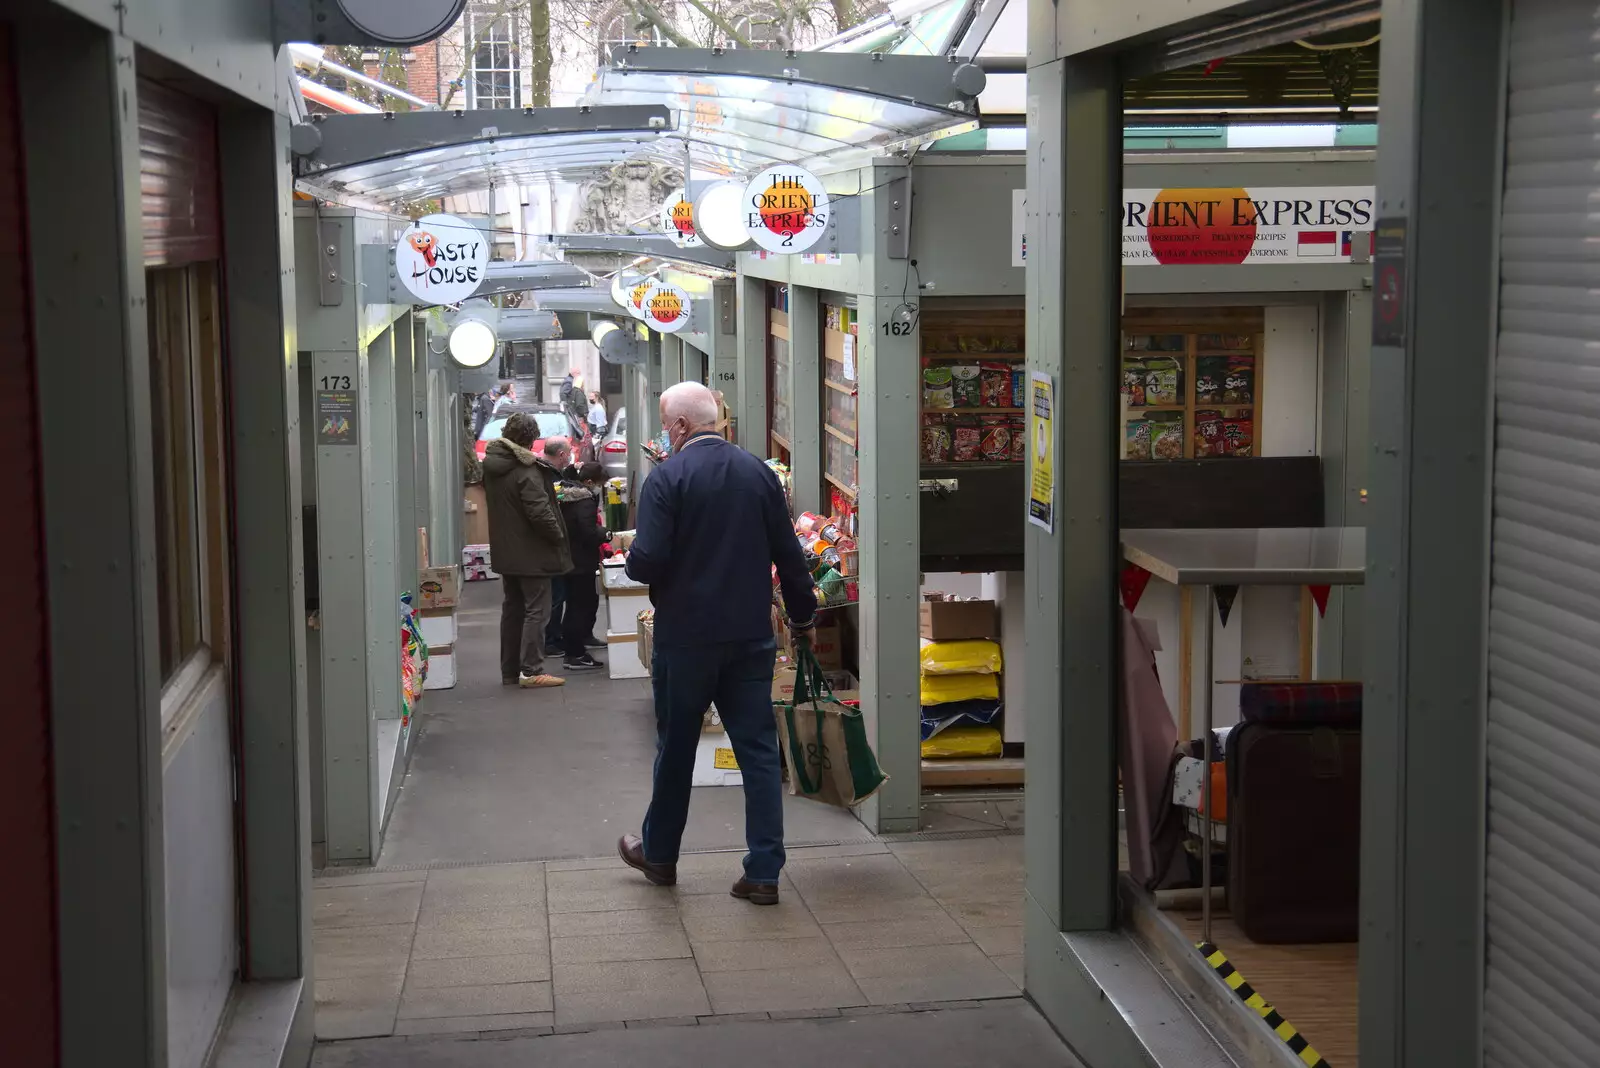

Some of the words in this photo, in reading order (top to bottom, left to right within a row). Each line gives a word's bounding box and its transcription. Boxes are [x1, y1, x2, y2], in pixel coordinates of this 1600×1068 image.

[768, 173, 804, 189] THE
[752, 193, 820, 208] ORIENT
[666, 206, 693, 217] ORI
[1121, 200, 1222, 229] RIENT
[1232, 197, 1373, 227] EXPRESS
[664, 219, 694, 230] EXPR
[781, 231, 793, 247] 2
[1121, 235, 1148, 243] ENUINE
[1253, 233, 1287, 241] RECIPES
[1121, 250, 1140, 258] SIAN
[1250, 249, 1289, 257] EVERYONE
[412, 260, 478, 289] HOUSE
[656, 287, 677, 296] THE
[646, 298, 686, 308] ORIENT
[644, 309, 689, 319] EXPRESS
[882, 321, 911, 336] 162
[320, 375, 351, 390] 173
[718, 372, 736, 381] 164
[800, 742, 832, 770] &S
